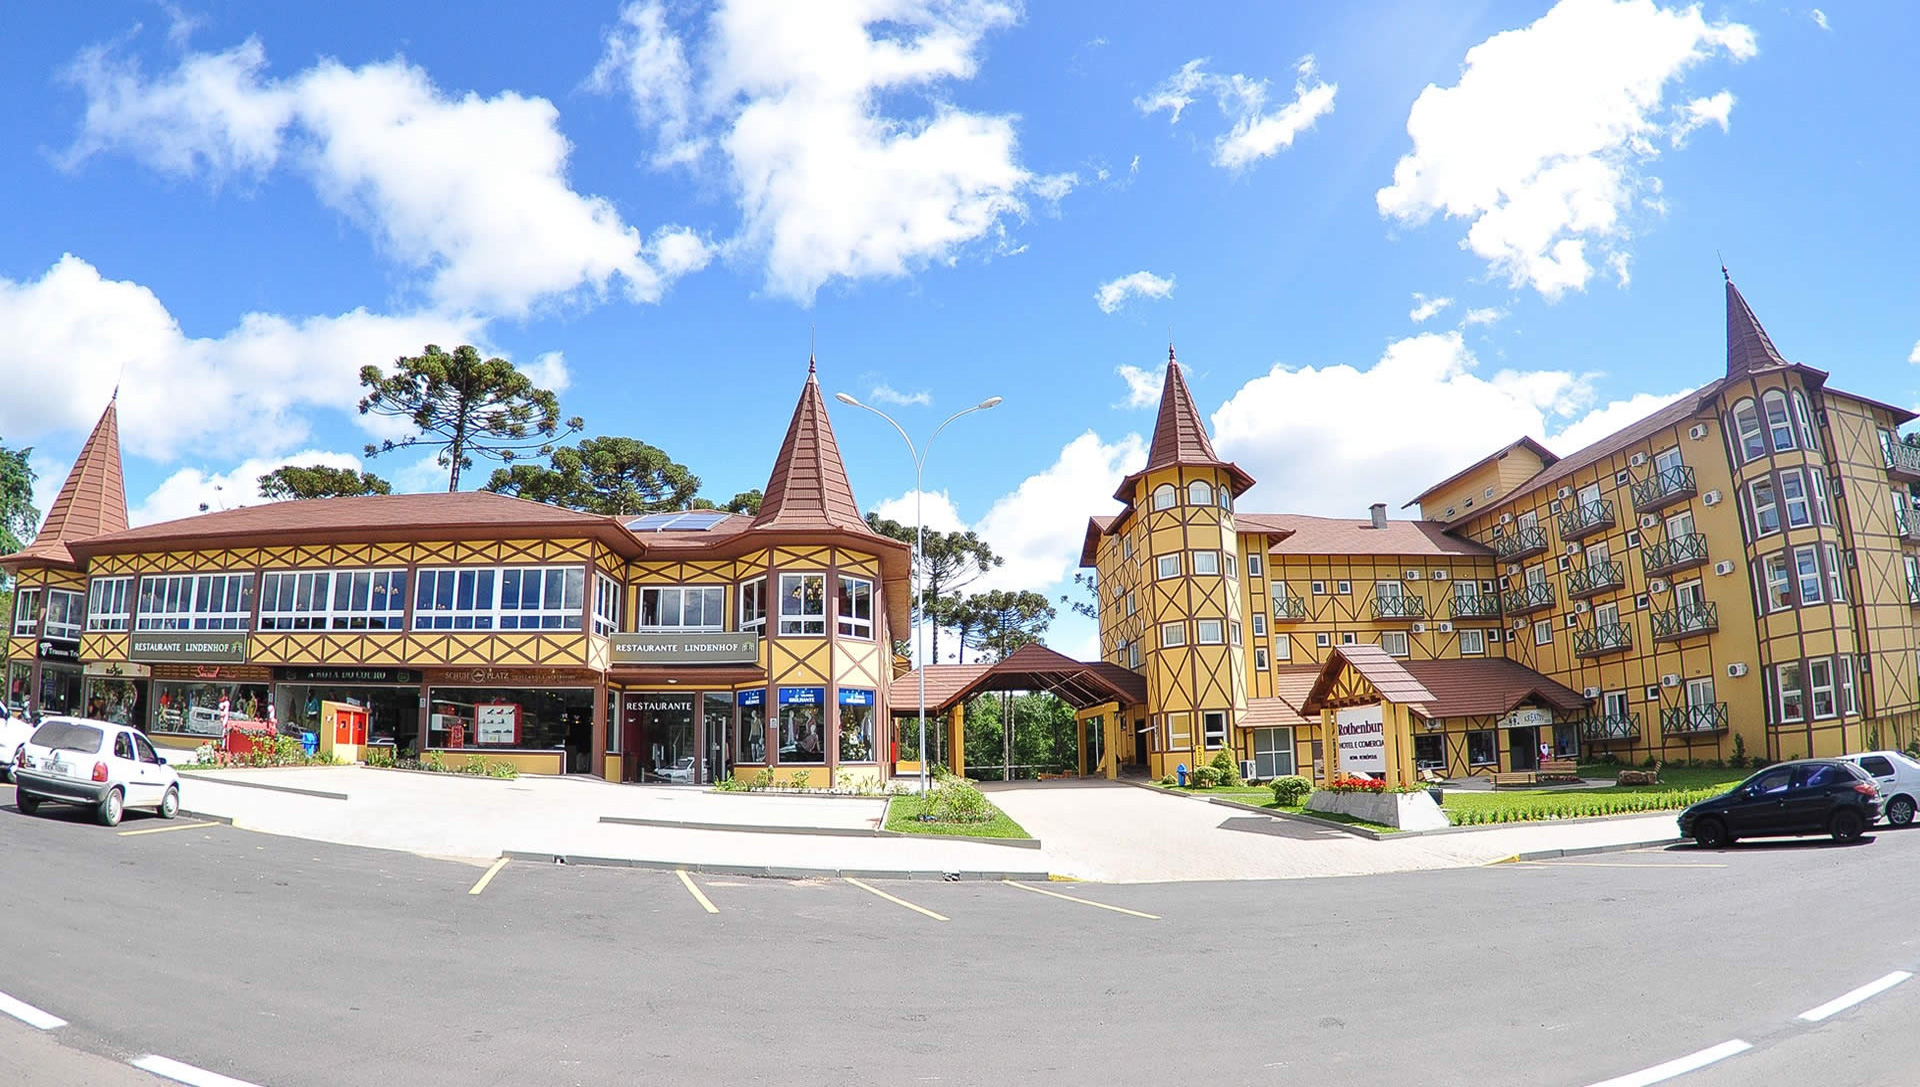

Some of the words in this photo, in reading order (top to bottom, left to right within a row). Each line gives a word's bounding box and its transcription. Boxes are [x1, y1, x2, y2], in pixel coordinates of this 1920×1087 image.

[134, 643, 181, 652] RESTAURANTE
[185, 643, 230, 653] LINDENHOF
[615, 643, 678, 652] RESTAURANTE
[684, 643, 738, 652] LINDENHOF
[626, 702, 692, 711] RESTAURANTE
